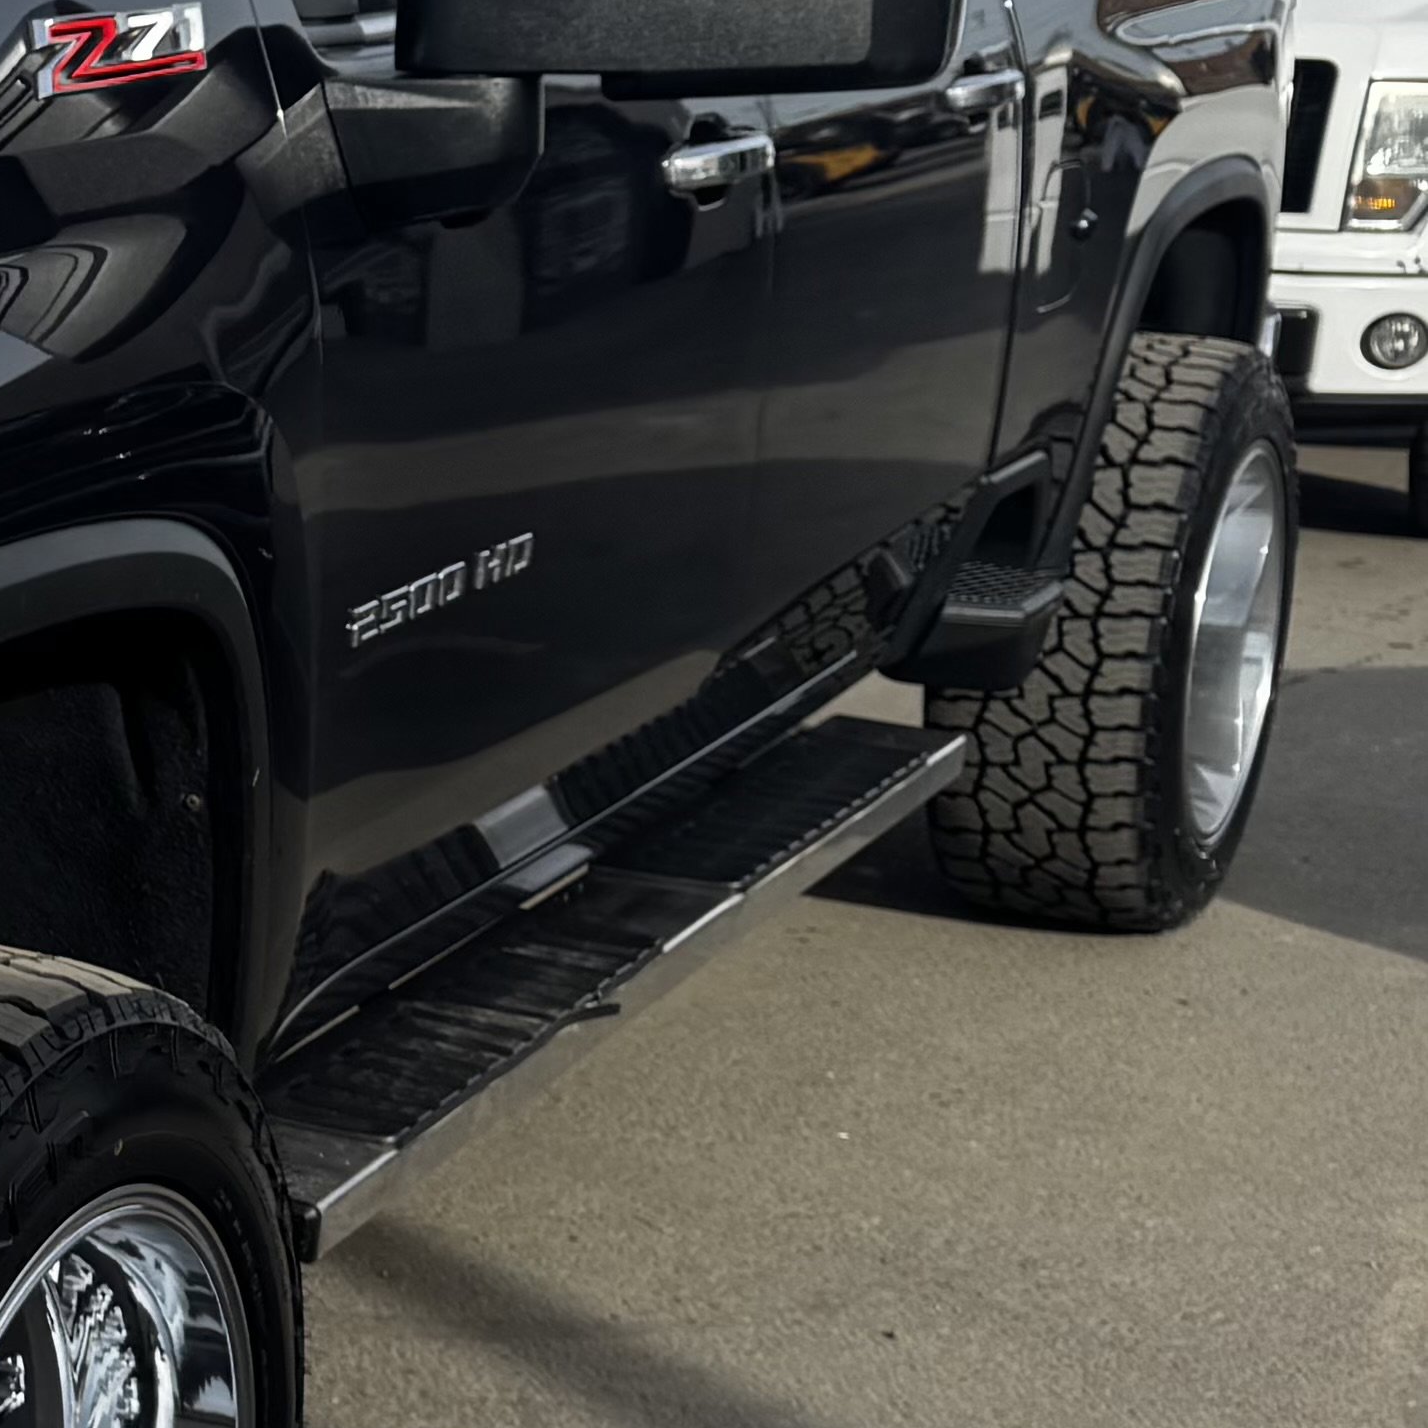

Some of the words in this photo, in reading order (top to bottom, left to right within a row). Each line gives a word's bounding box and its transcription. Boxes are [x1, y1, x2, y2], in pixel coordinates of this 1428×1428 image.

[36, 2, 207, 97] Z71
[346, 560, 466, 648] 2500
[473, 531, 533, 590] HD
